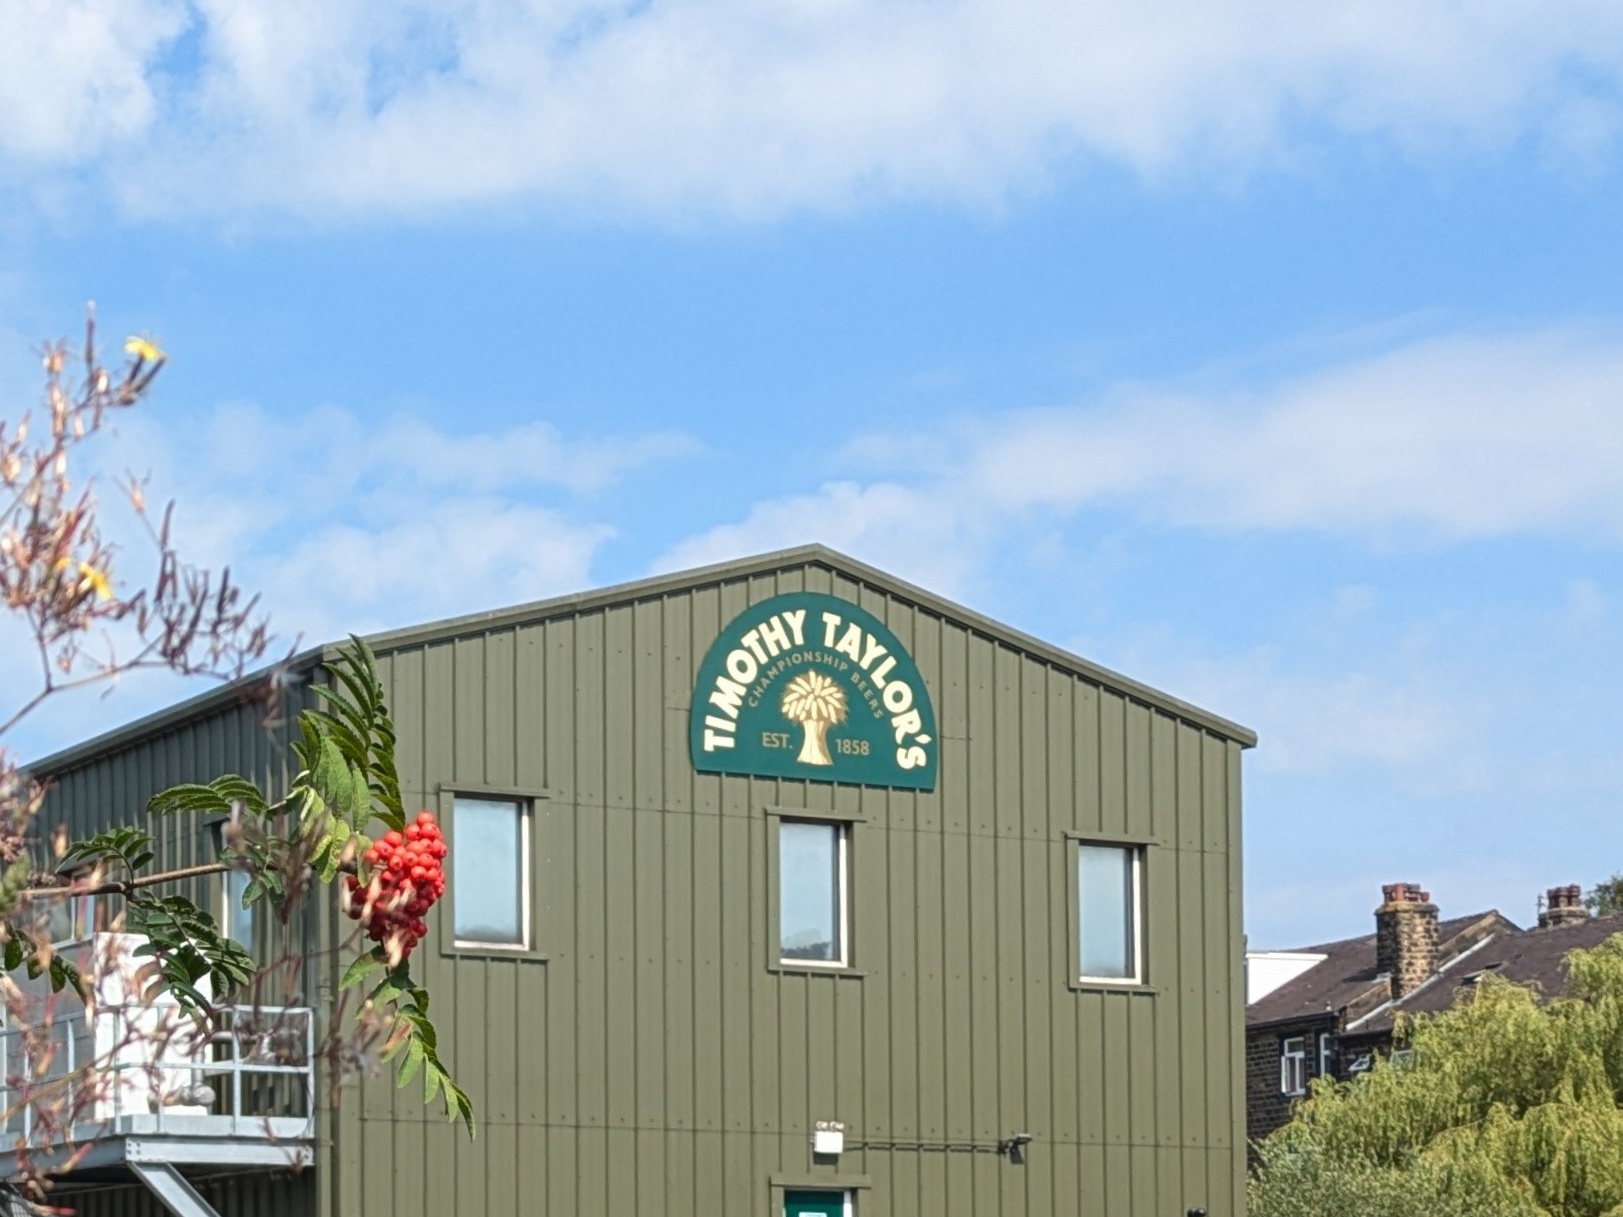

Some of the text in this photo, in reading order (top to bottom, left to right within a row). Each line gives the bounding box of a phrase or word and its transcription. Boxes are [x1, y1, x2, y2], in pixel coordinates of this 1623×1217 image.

[704, 609, 932, 770] TIMOTHY TAYLOR'S
[748, 651, 883, 719] CHAMPIONSHIP BEERS
[762, 732, 870, 756] EST. 1858
